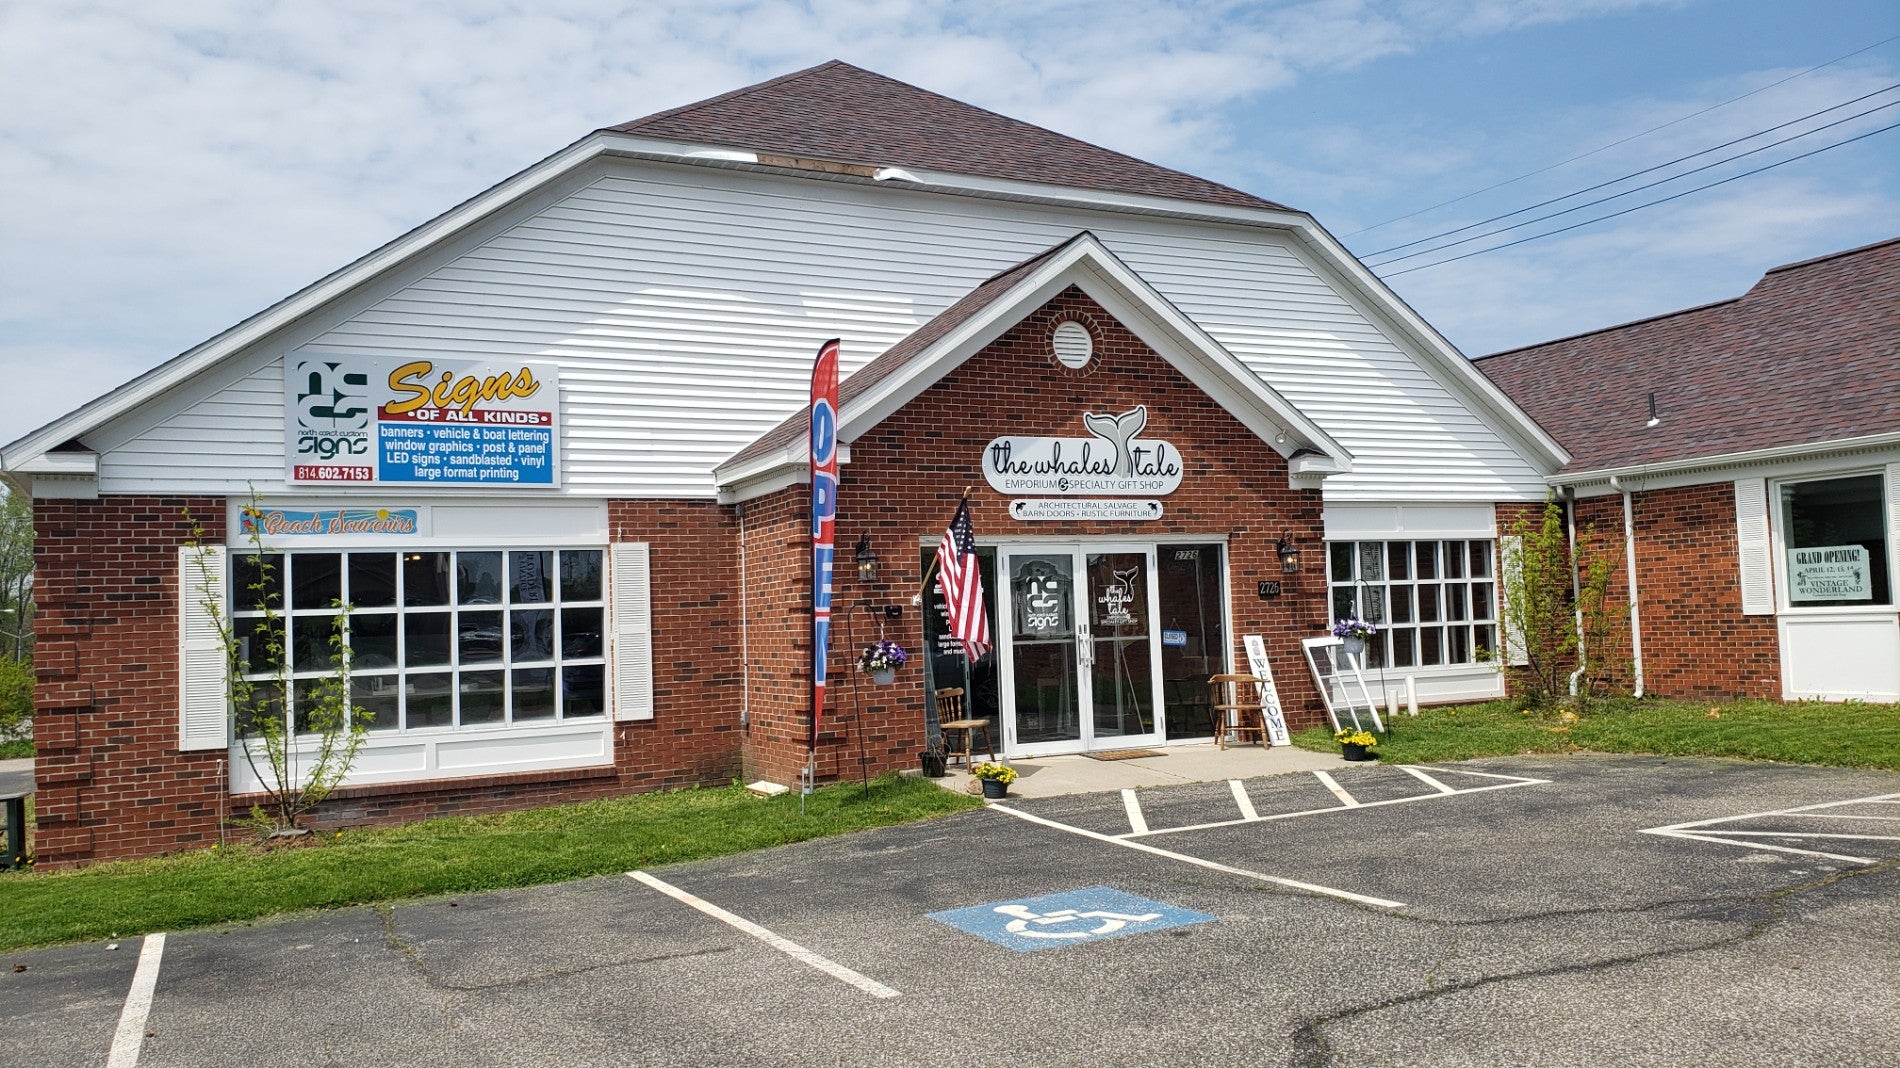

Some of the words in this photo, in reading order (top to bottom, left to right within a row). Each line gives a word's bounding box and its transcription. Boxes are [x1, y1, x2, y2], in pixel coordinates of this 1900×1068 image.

[385, 360, 540, 416] Signs
[417, 410, 439, 421] OF
[446, 410, 478, 422] ALL
[484, 412, 539, 423] KINDS
[381, 426, 424, 438] banners
[433, 428, 470, 439] vehicle
[473, 429, 481, 439] &
[483, 429, 505, 440] boat
[508, 429, 549, 443] lettering
[298, 436, 368, 460] signs
[385, 439, 426, 451] window
[429, 441, 473, 454] graphics
[483, 442, 505, 455] post
[508, 443, 516, 453] &
[518, 443, 545, 456] panel
[387, 452, 409, 463] LED
[412, 453, 440, 466] signs
[450, 454, 512, 466] sandblasted
[521, 455, 544, 468] vinyl
[991, 441, 1032, 474] the
[1035, 441, 1112, 475] whales
[1133, 444, 1179, 476] tale
[298, 467, 369, 480] 814.602.7153
[415, 466, 441, 480] large
[444, 467, 478, 478] format
[480, 467, 519, 480] printing
[1005, 480, 1057, 489] EMPORIUM
[1069, 480, 1115, 489] SPECIALTY
[1118, 481, 1138, 489] GIFT
[1140, 481, 1164, 490] SHOP
[1038, 502, 1102, 510] ARCHITECTURAL
[265, 511, 322, 535] Beach
[328, 510, 413, 534] Souvenirs
[1176, 550, 1198, 559] 2726
[1796, 551, 1822, 564] GRAND
[1824, 549, 1860, 563] OPENING!
[1260, 582, 1279, 594] 2726
[1799, 586, 1863, 594] WONDERLAND
[1028, 617, 1059, 630] signs
[1253, 658, 1286, 740] WELCOME
